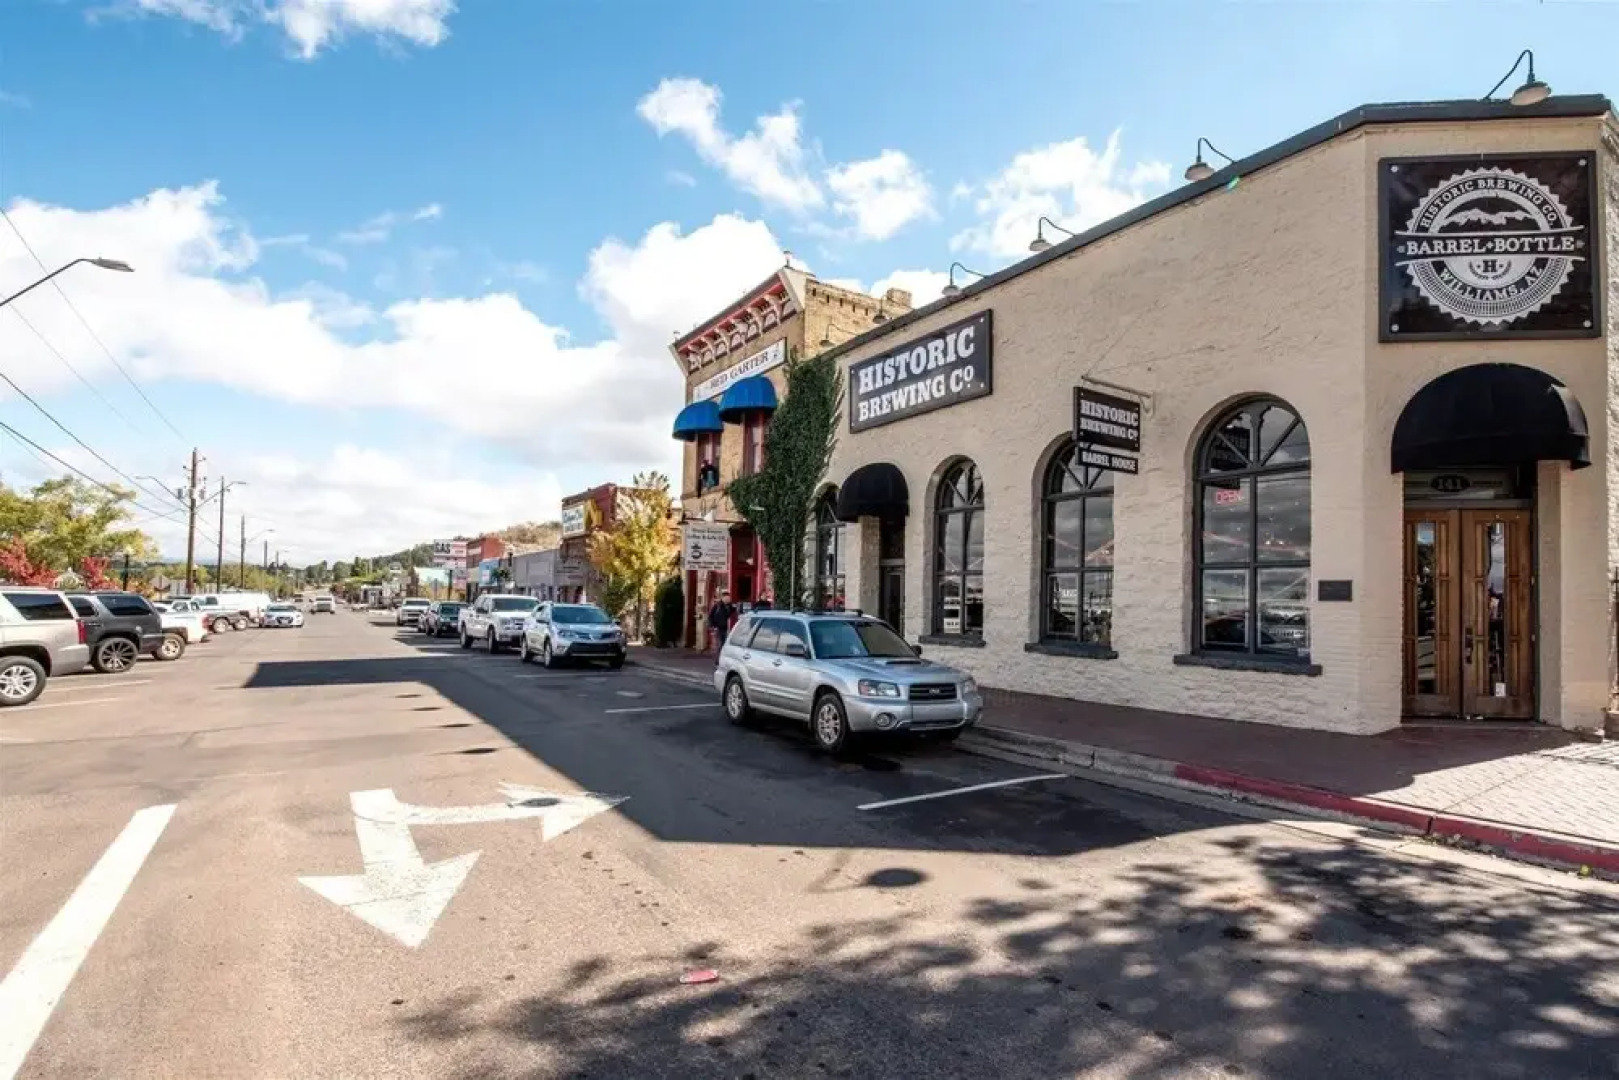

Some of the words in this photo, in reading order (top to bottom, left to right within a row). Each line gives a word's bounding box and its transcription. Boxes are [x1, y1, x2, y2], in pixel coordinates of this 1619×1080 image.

[1420, 179, 1474, 228] HISTORIC
[1478, 179, 1543, 205] BREWING
[1482, 259, 1498, 273] H
[729, 350, 769, 379] GARTER
[859, 326, 975, 394] HISTORIC
[858, 374, 945, 421] BREWING
[1081, 399, 1138, 427] HISTORIC
[1081, 417, 1126, 438] BREWING
[1082, 451, 1110, 467] BARREL
[1111, 456, 1136, 471] HOUSE
